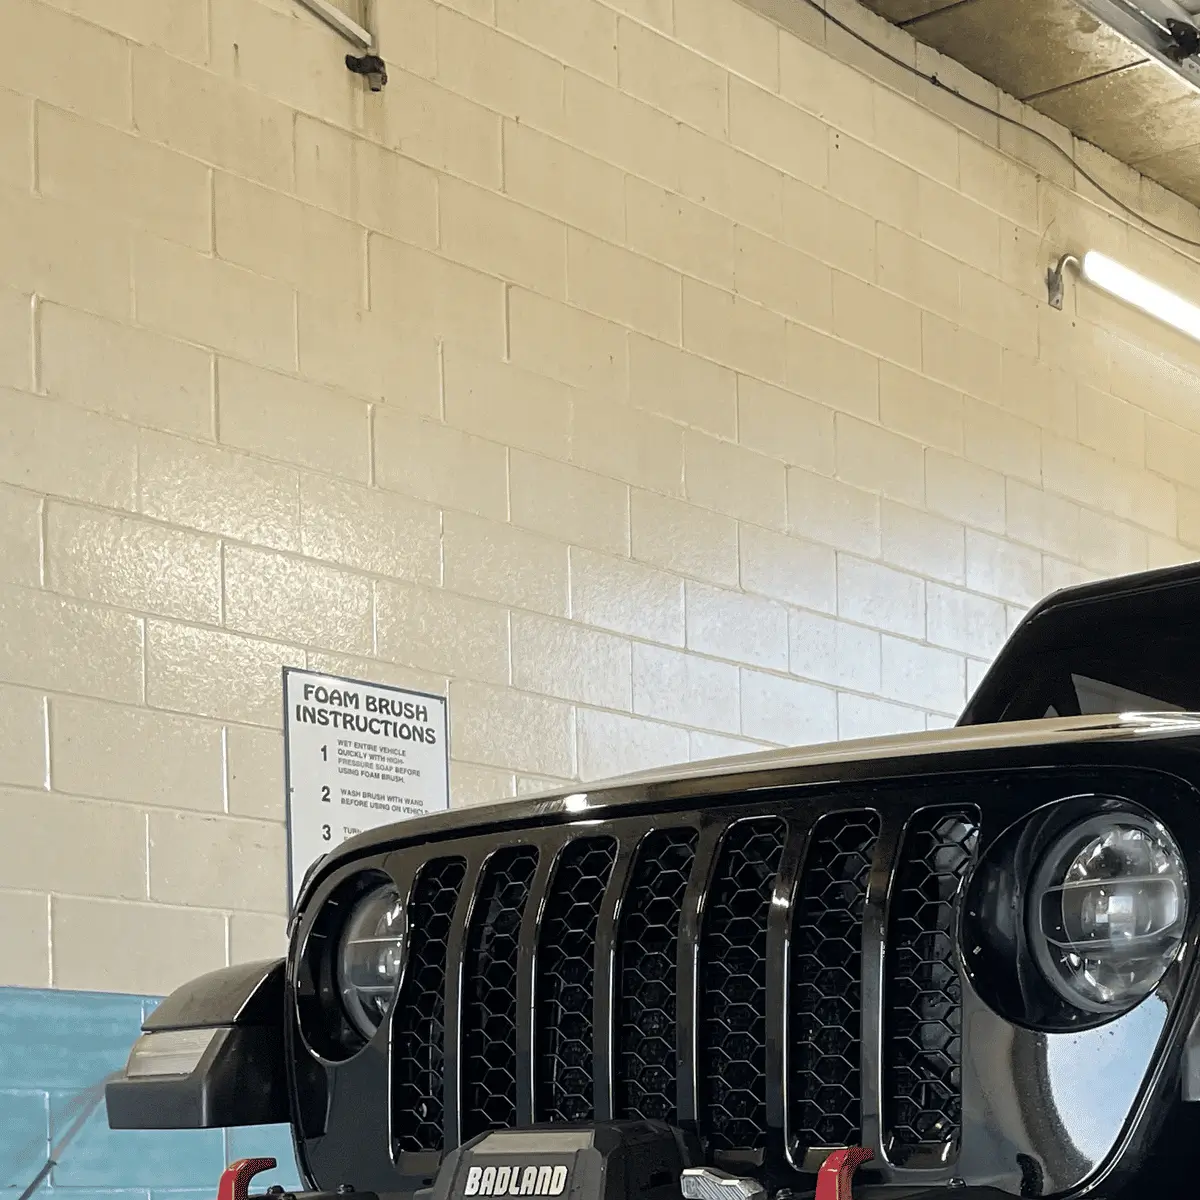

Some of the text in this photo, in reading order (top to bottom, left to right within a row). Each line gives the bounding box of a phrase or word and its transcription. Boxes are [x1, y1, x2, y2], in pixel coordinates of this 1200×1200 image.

[303, 683, 428, 722] FOAM BRUSH
[296, 704, 436, 744] INSTRUCTIONS
[320, 745, 327, 761] 1
[321, 785, 331, 803] 2
[322, 824, 331, 841] 3
[464, 1165, 568, 1196] BADLAND
